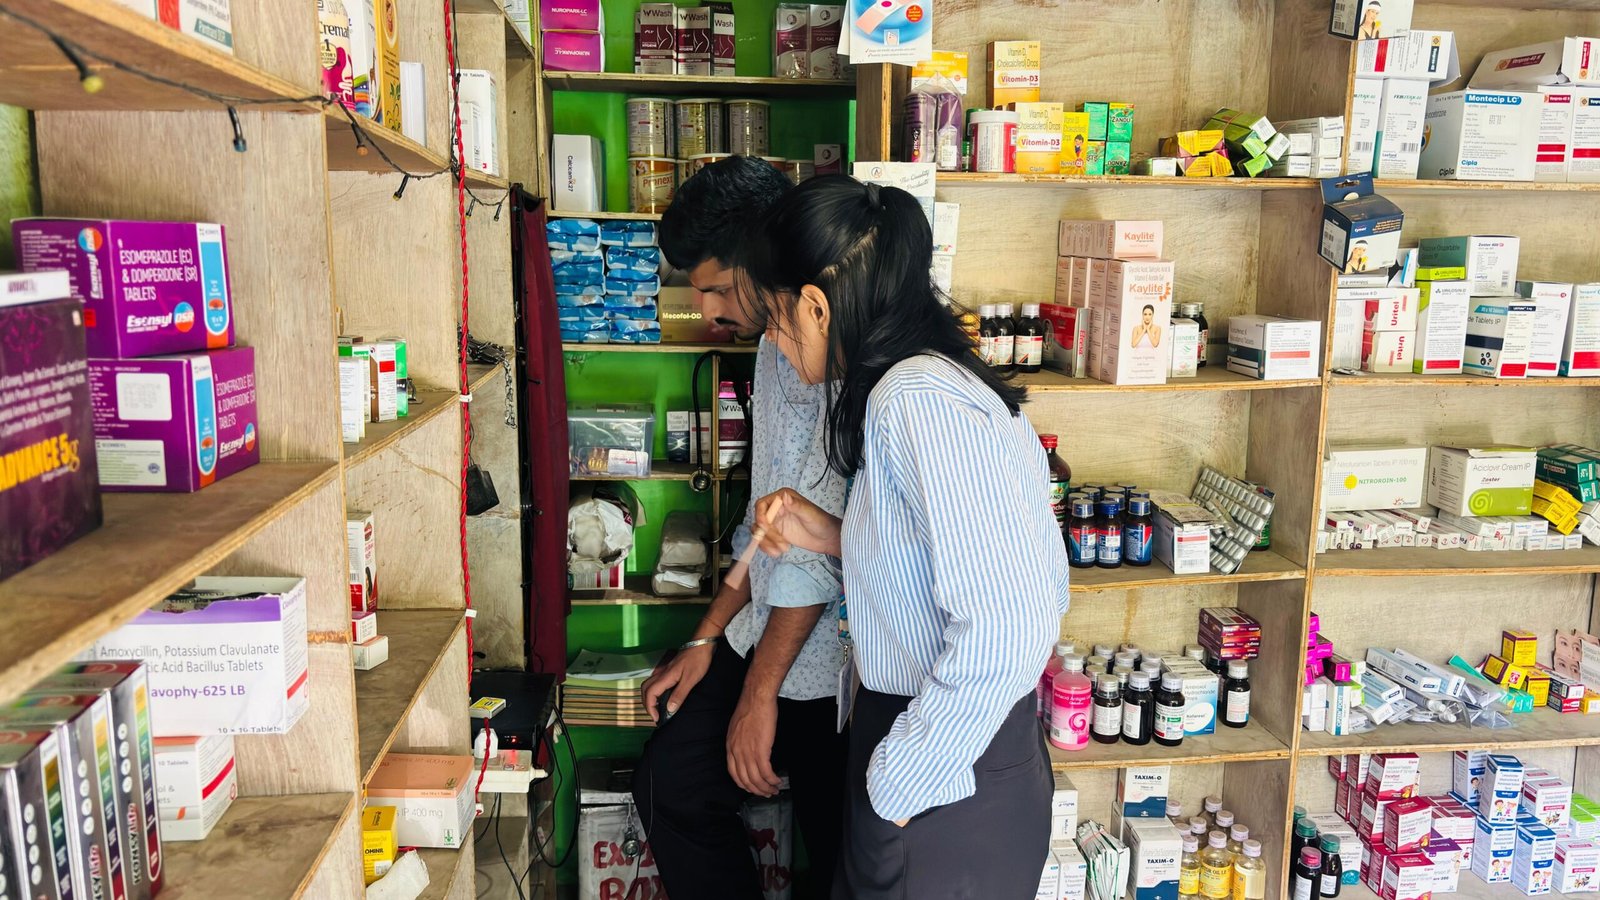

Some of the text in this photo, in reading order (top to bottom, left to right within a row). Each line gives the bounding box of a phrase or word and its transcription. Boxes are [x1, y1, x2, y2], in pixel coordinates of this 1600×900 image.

[1469, 94, 1505, 103] Montecip
[1124, 231, 1154, 243] Kaylite
[119, 247, 193, 265] ESOMEPRAZOLE (EC)
[122, 266, 198, 284] & DOMPERIDONE (SR)
[122, 286, 157, 301] TABLETS
[1129, 284, 1163, 296] Kaylite
[1475, 316, 1494, 324] Tablets
[1473, 462, 1531, 472] Aciclovir Cream IP
[100, 643, 280, 659] Amoxycillin, Potassium Clavulanate
[161, 661, 184, 673] Acid
[186, 660, 225, 672] Bacillus
[228, 659, 264, 672] Tablets
[151, 685, 246, 699] avophy-625 LB
[250, 725, 282, 733] Tablets
[401, 807, 443, 819] IP 400 mg
